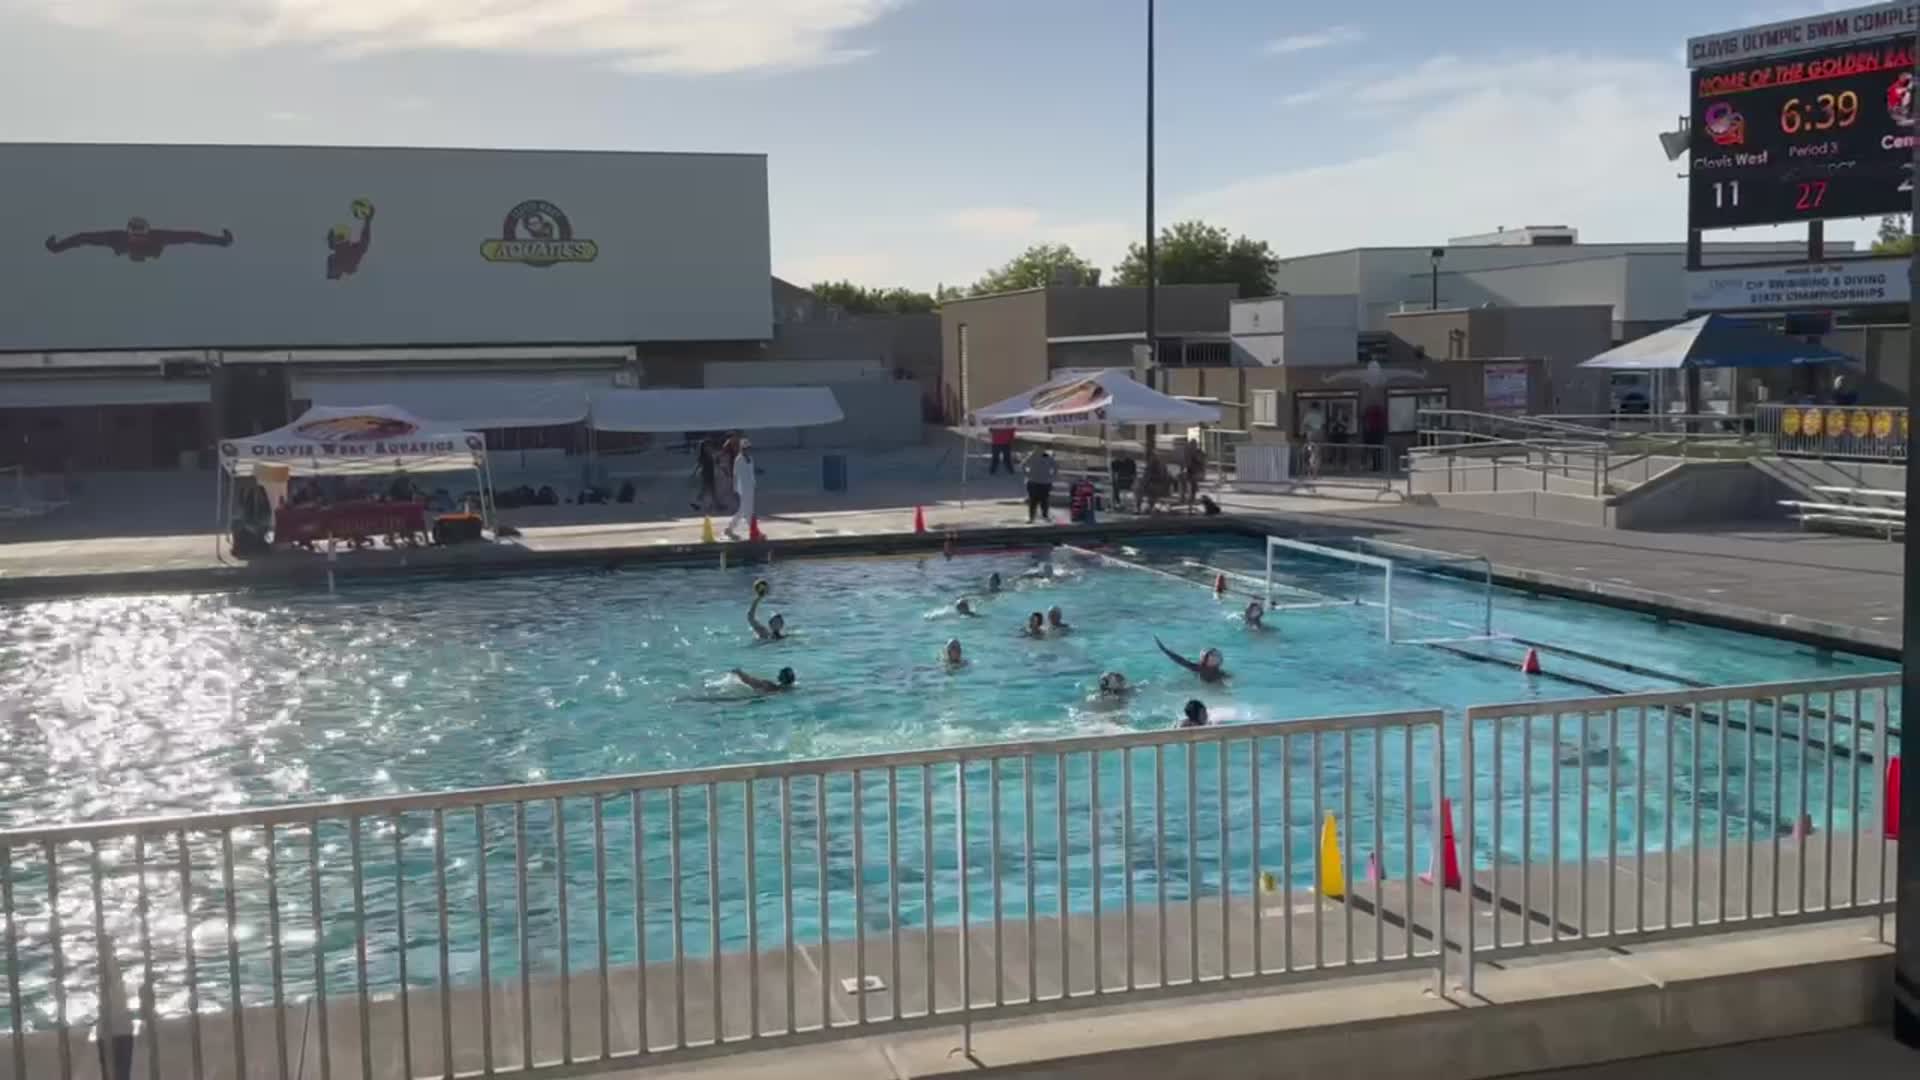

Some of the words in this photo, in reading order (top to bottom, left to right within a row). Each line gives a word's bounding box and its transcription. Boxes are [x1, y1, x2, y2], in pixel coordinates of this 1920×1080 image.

[1693, 36, 1738, 60] CLOVIS
[1742, 25, 1802, 53] OLYMPIC
[1807, 17, 1849, 41] SWIM
[1854, 7, 1920, 33] COMPLE
[1749, 66, 1773, 88] OF
[1807, 51, 1878, 77] GOLDEN
[1781, 90, 1858, 133] 6:39
[1735, 149, 1769, 167] West
[1789, 142, 1828, 157] Period
[1713, 180, 1739, 209] 11
[1796, 180, 1827, 210] 27
[1843, 272, 1886, 287] DIVING
